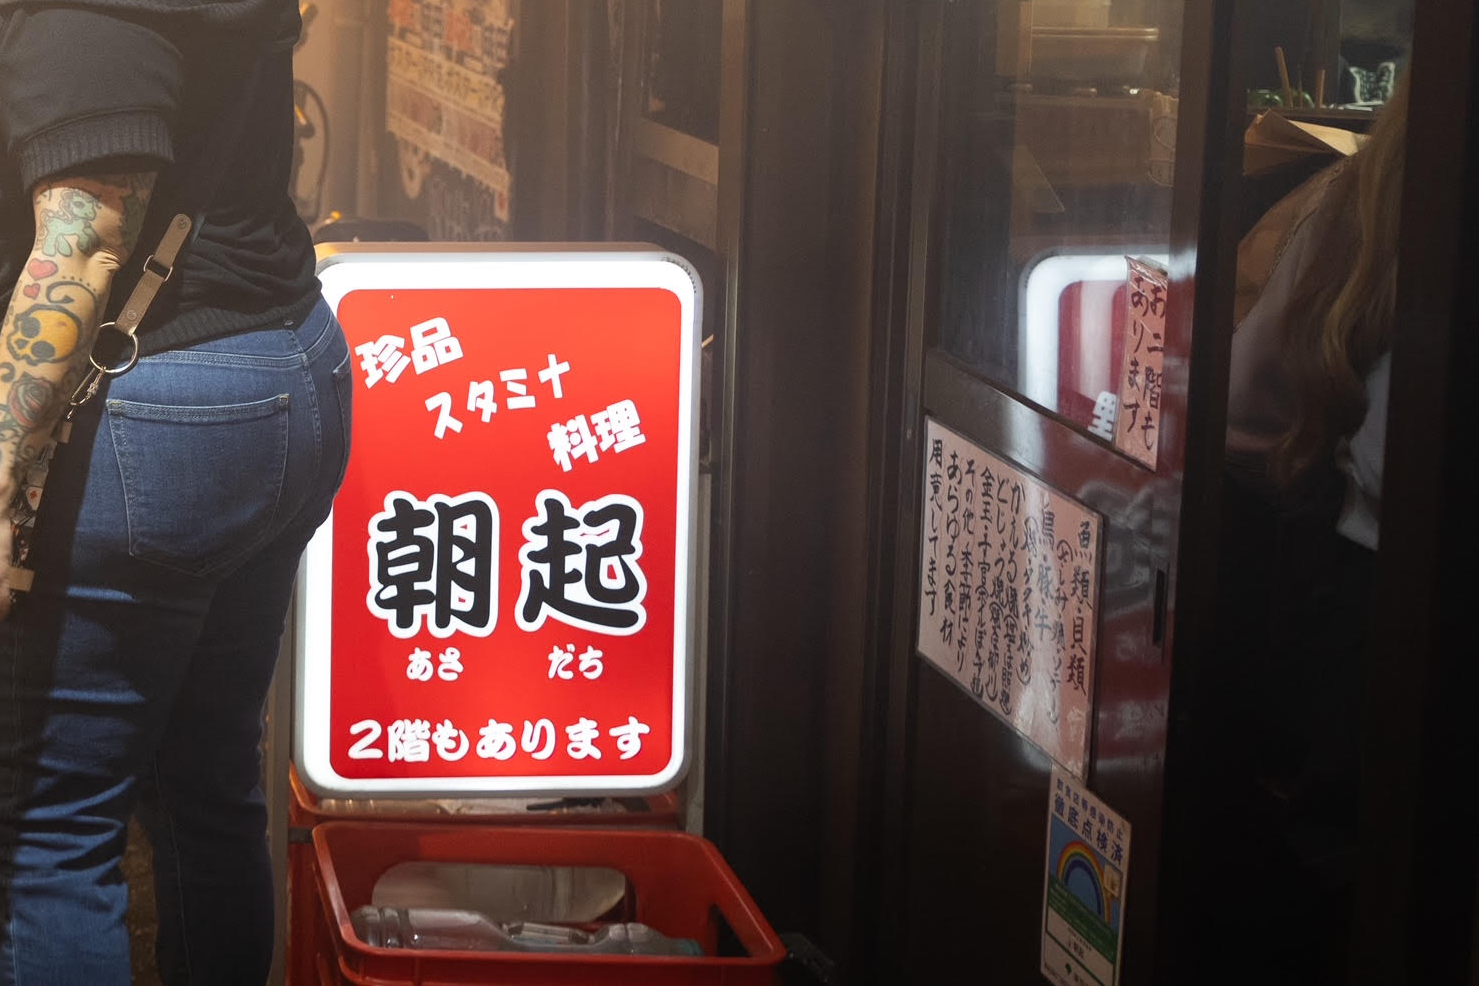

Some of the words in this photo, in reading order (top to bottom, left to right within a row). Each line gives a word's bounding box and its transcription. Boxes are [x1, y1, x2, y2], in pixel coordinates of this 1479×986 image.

[354, 316, 464, 390] 珍品
[424, 352, 571, 441] スタミナ
[1123, 276, 1149, 434] あります
[545, 397, 647, 473] 料理
[369, 493, 645, 635] 朝起
[924, 437, 944, 618] 用意してます
[939, 451, 963, 648] あらゆる食材
[405, 645, 465, 683] あさ
[547, 643, 605, 681] だち
[347, 716, 651, 765] 2階もあります
